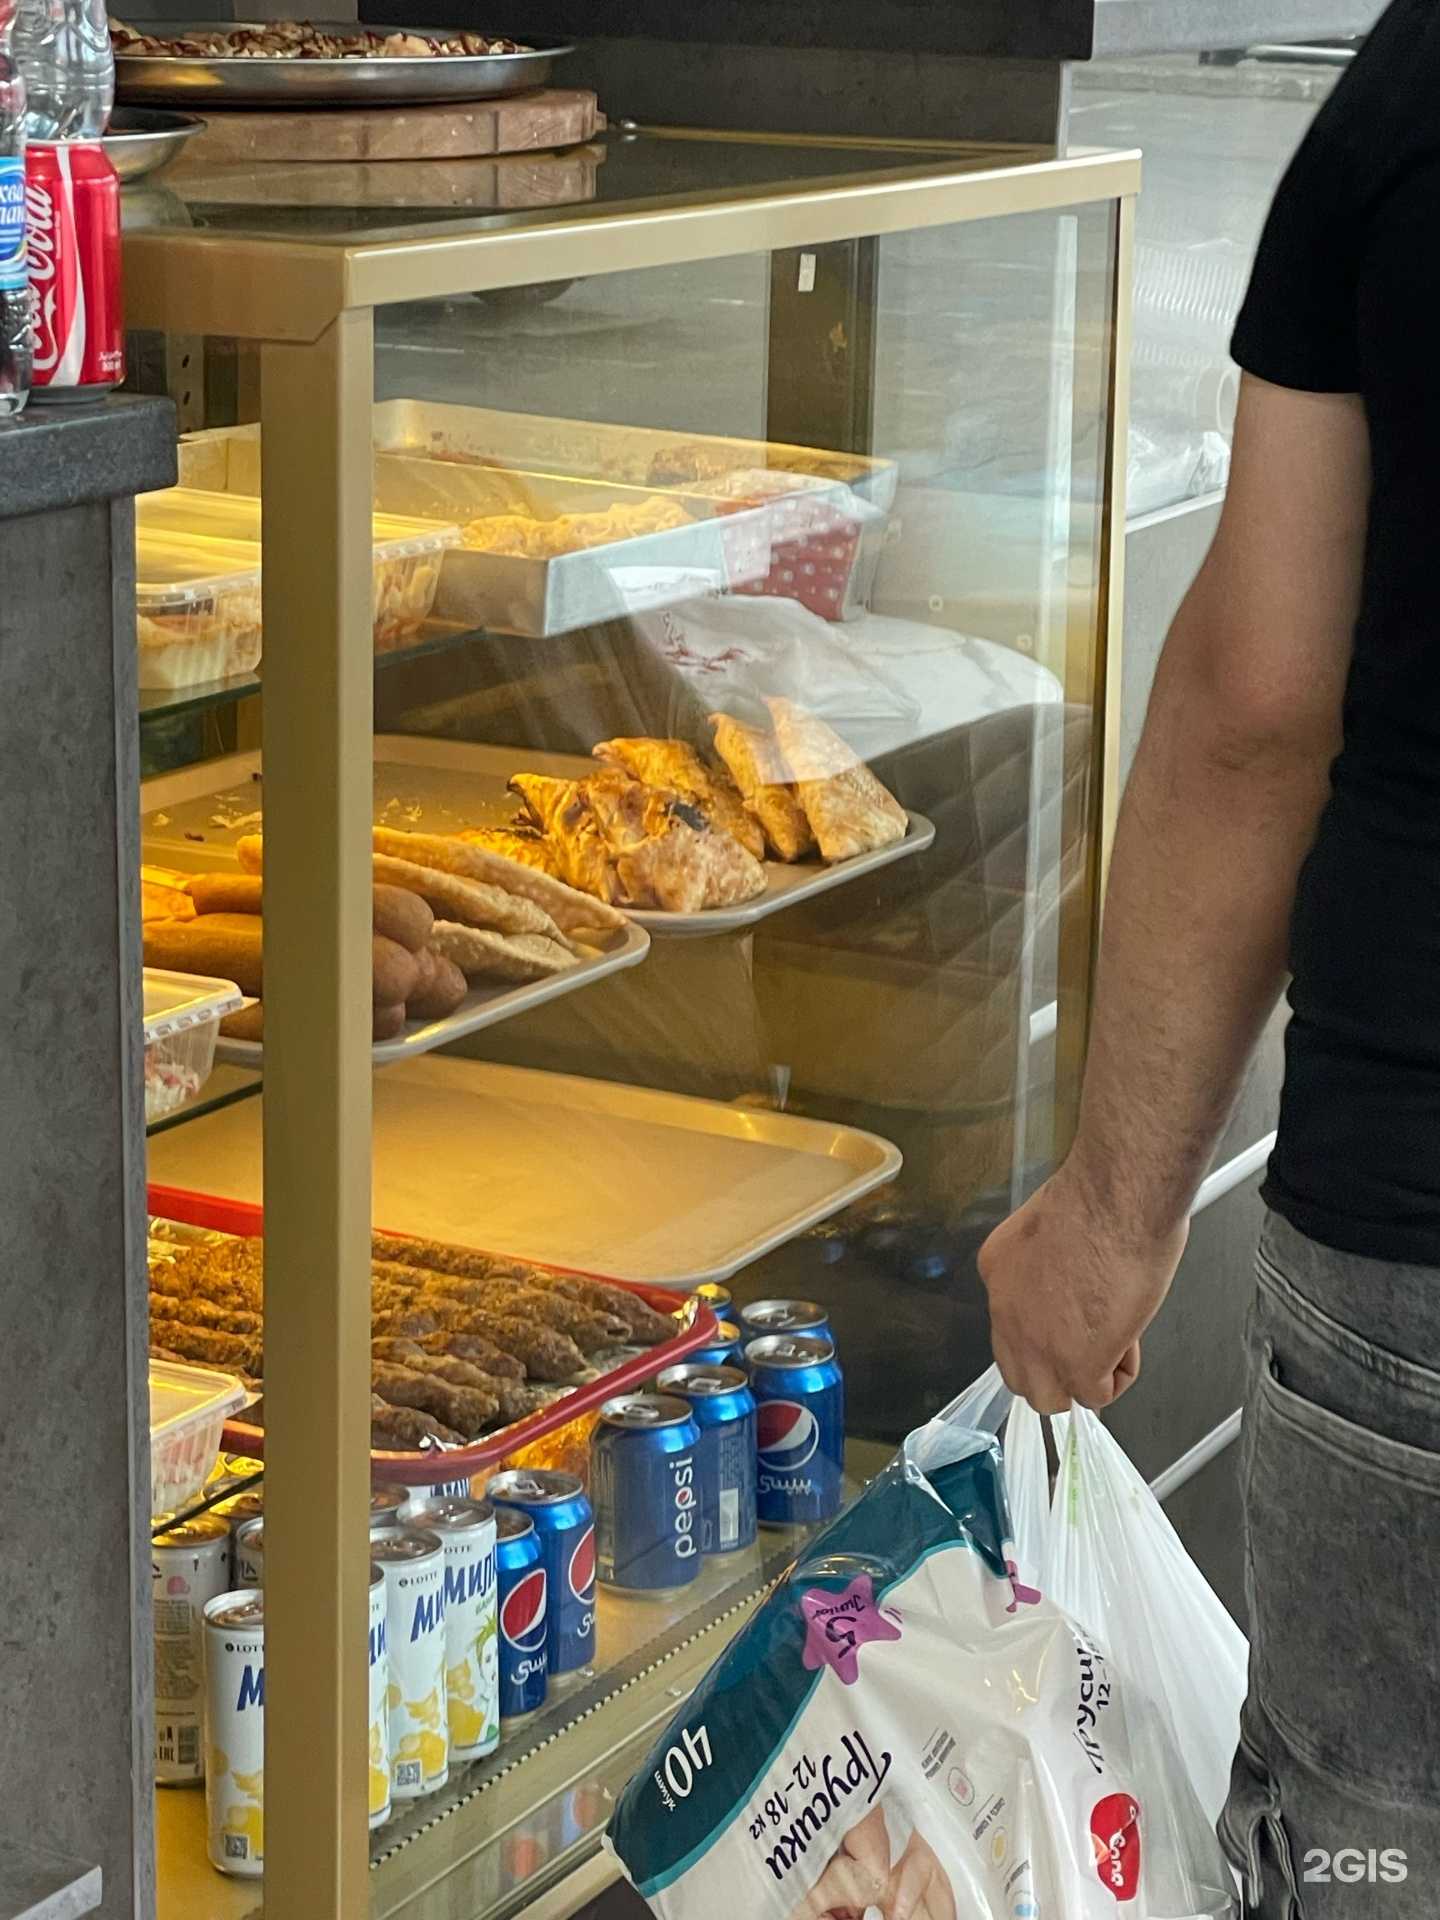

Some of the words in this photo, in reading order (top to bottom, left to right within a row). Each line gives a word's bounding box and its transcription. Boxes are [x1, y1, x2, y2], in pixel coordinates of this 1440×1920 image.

[669, 1456, 697, 1558] pepsi
[812, 1594, 865, 1620] Junior
[825, 1616, 857, 1659] 5
[664, 1725, 713, 1797] 40
[653, 1769, 677, 1812] штук
[765, 1730, 892, 1880] Трусики
[749, 1813, 767, 1840] кг
